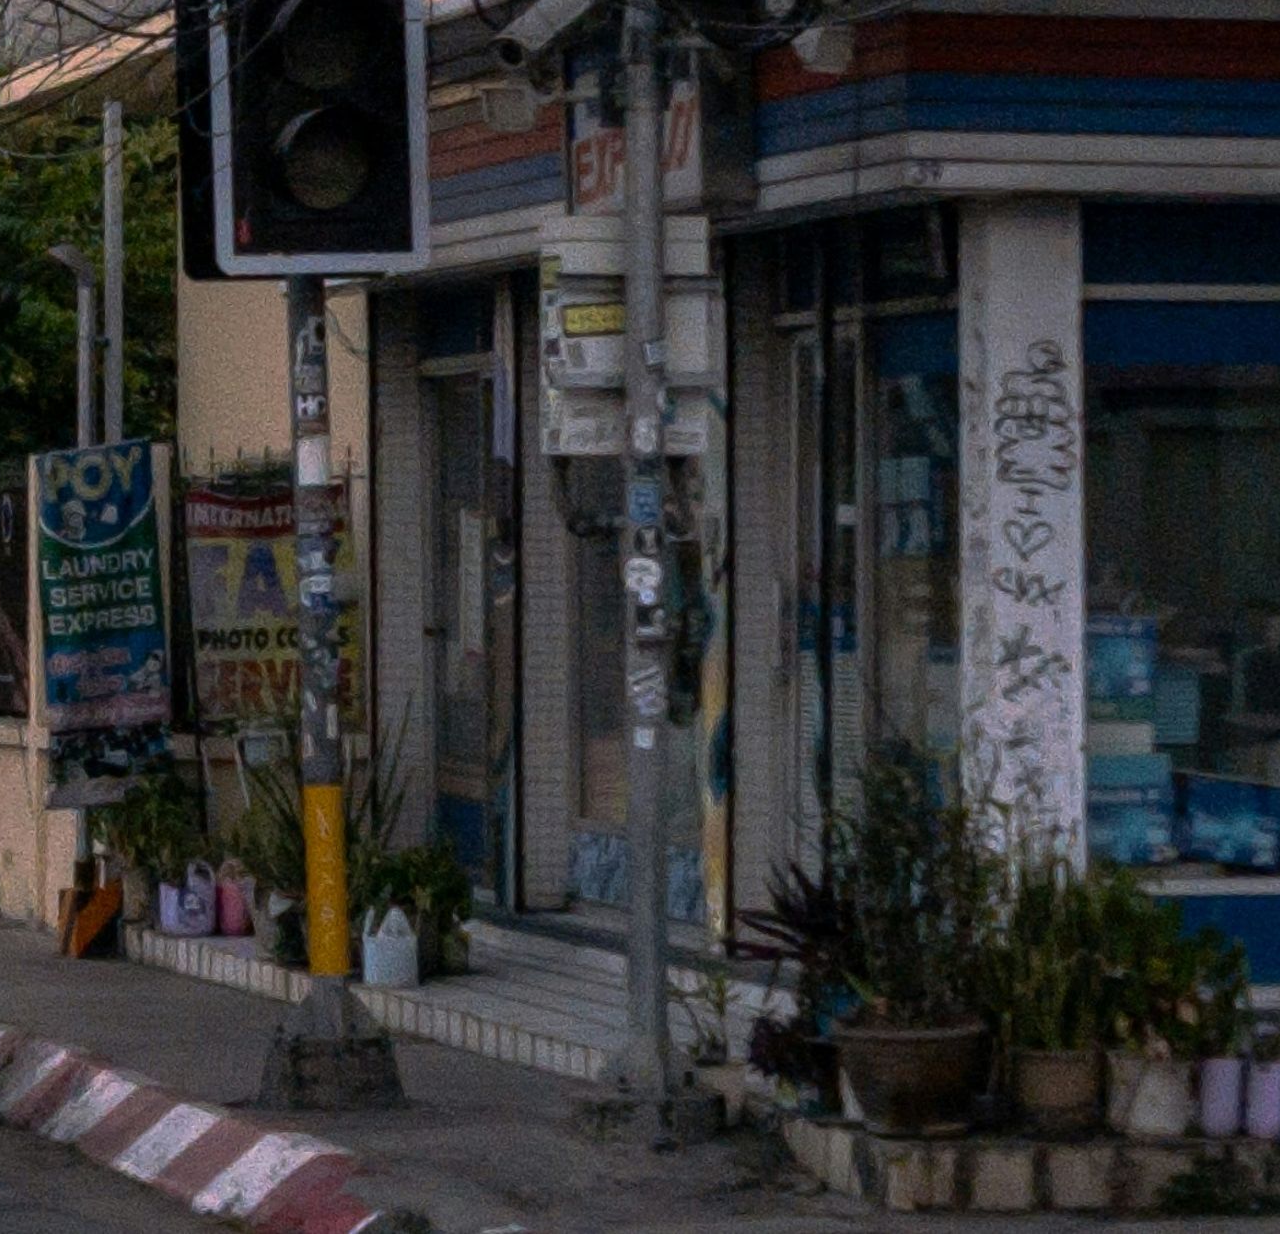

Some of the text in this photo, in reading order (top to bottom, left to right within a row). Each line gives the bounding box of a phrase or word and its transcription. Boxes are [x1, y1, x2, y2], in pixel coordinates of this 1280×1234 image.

[47, 445, 142, 501] POY
[42, 547, 155, 581] LAUNDRY
[49, 576, 152, 611] SERVICE
[48, 604, 158, 637] EXPRESS
[198, 627, 269, 650] PHOTO
